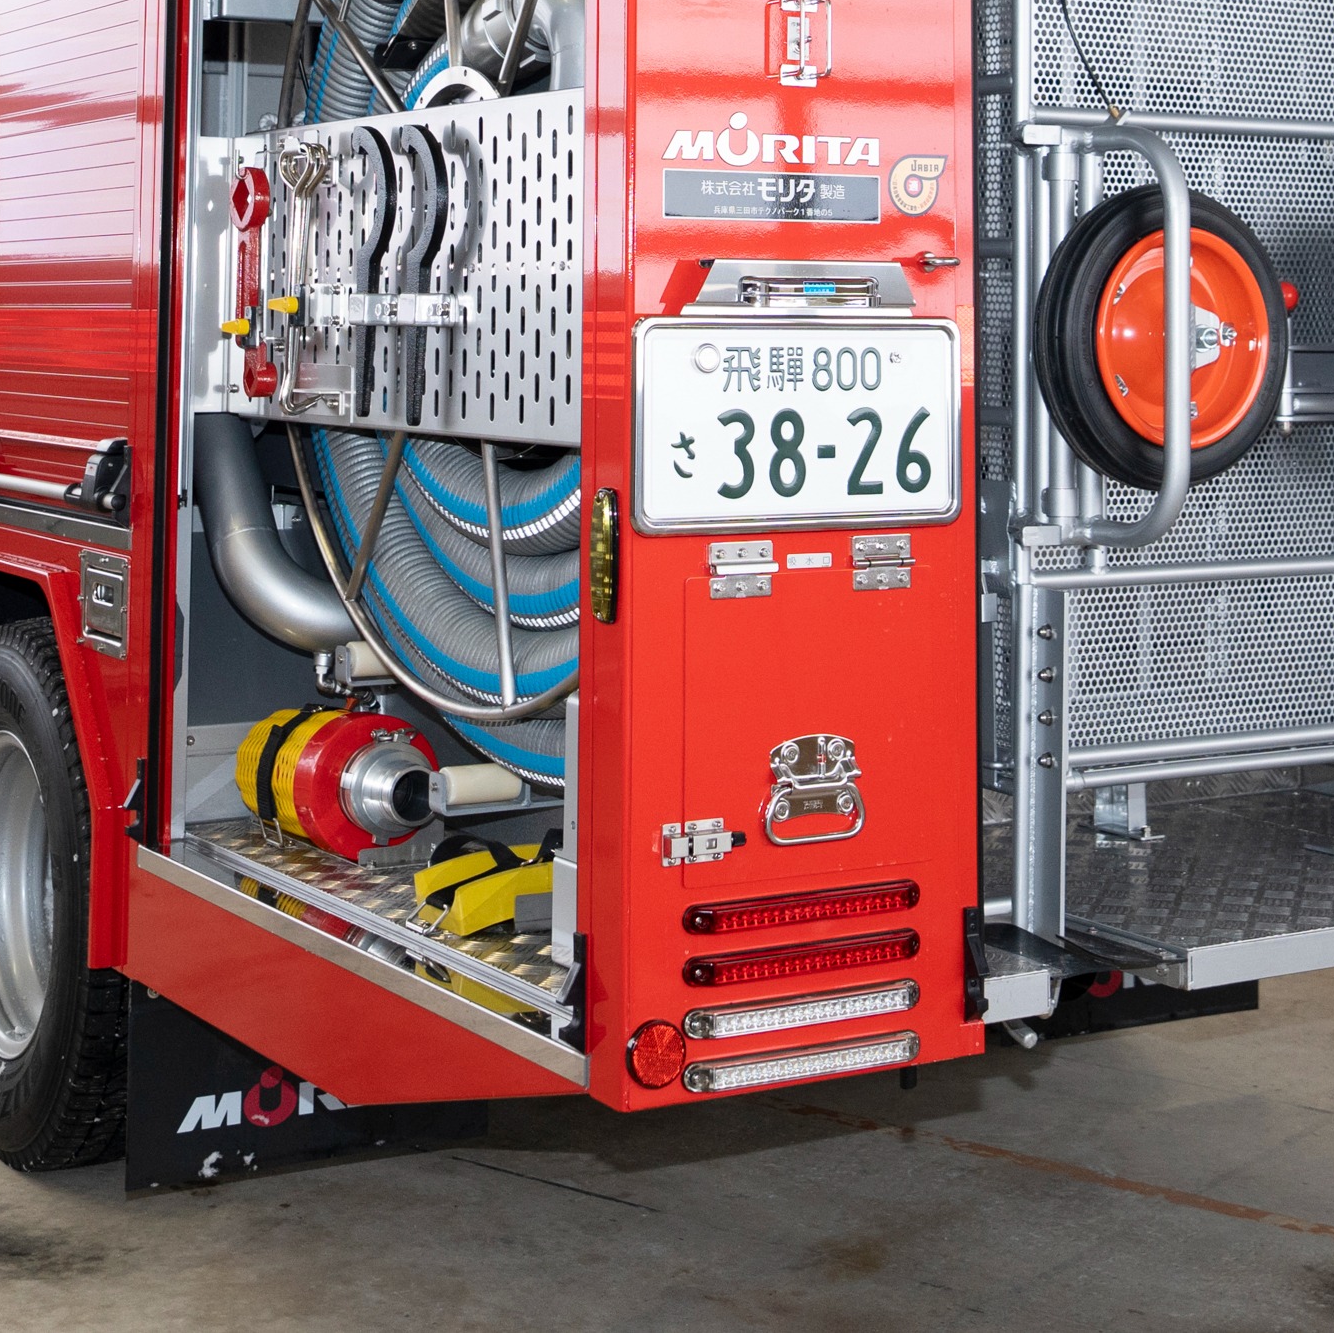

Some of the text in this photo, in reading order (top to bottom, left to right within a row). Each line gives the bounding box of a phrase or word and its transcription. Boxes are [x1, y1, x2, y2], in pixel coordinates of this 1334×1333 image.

[661, 111, 880, 167] MORITA
[911, 160, 939, 172] JABIA
[811, 346, 882, 392] 800
[670, 406, 931, 500] さ 38-26
